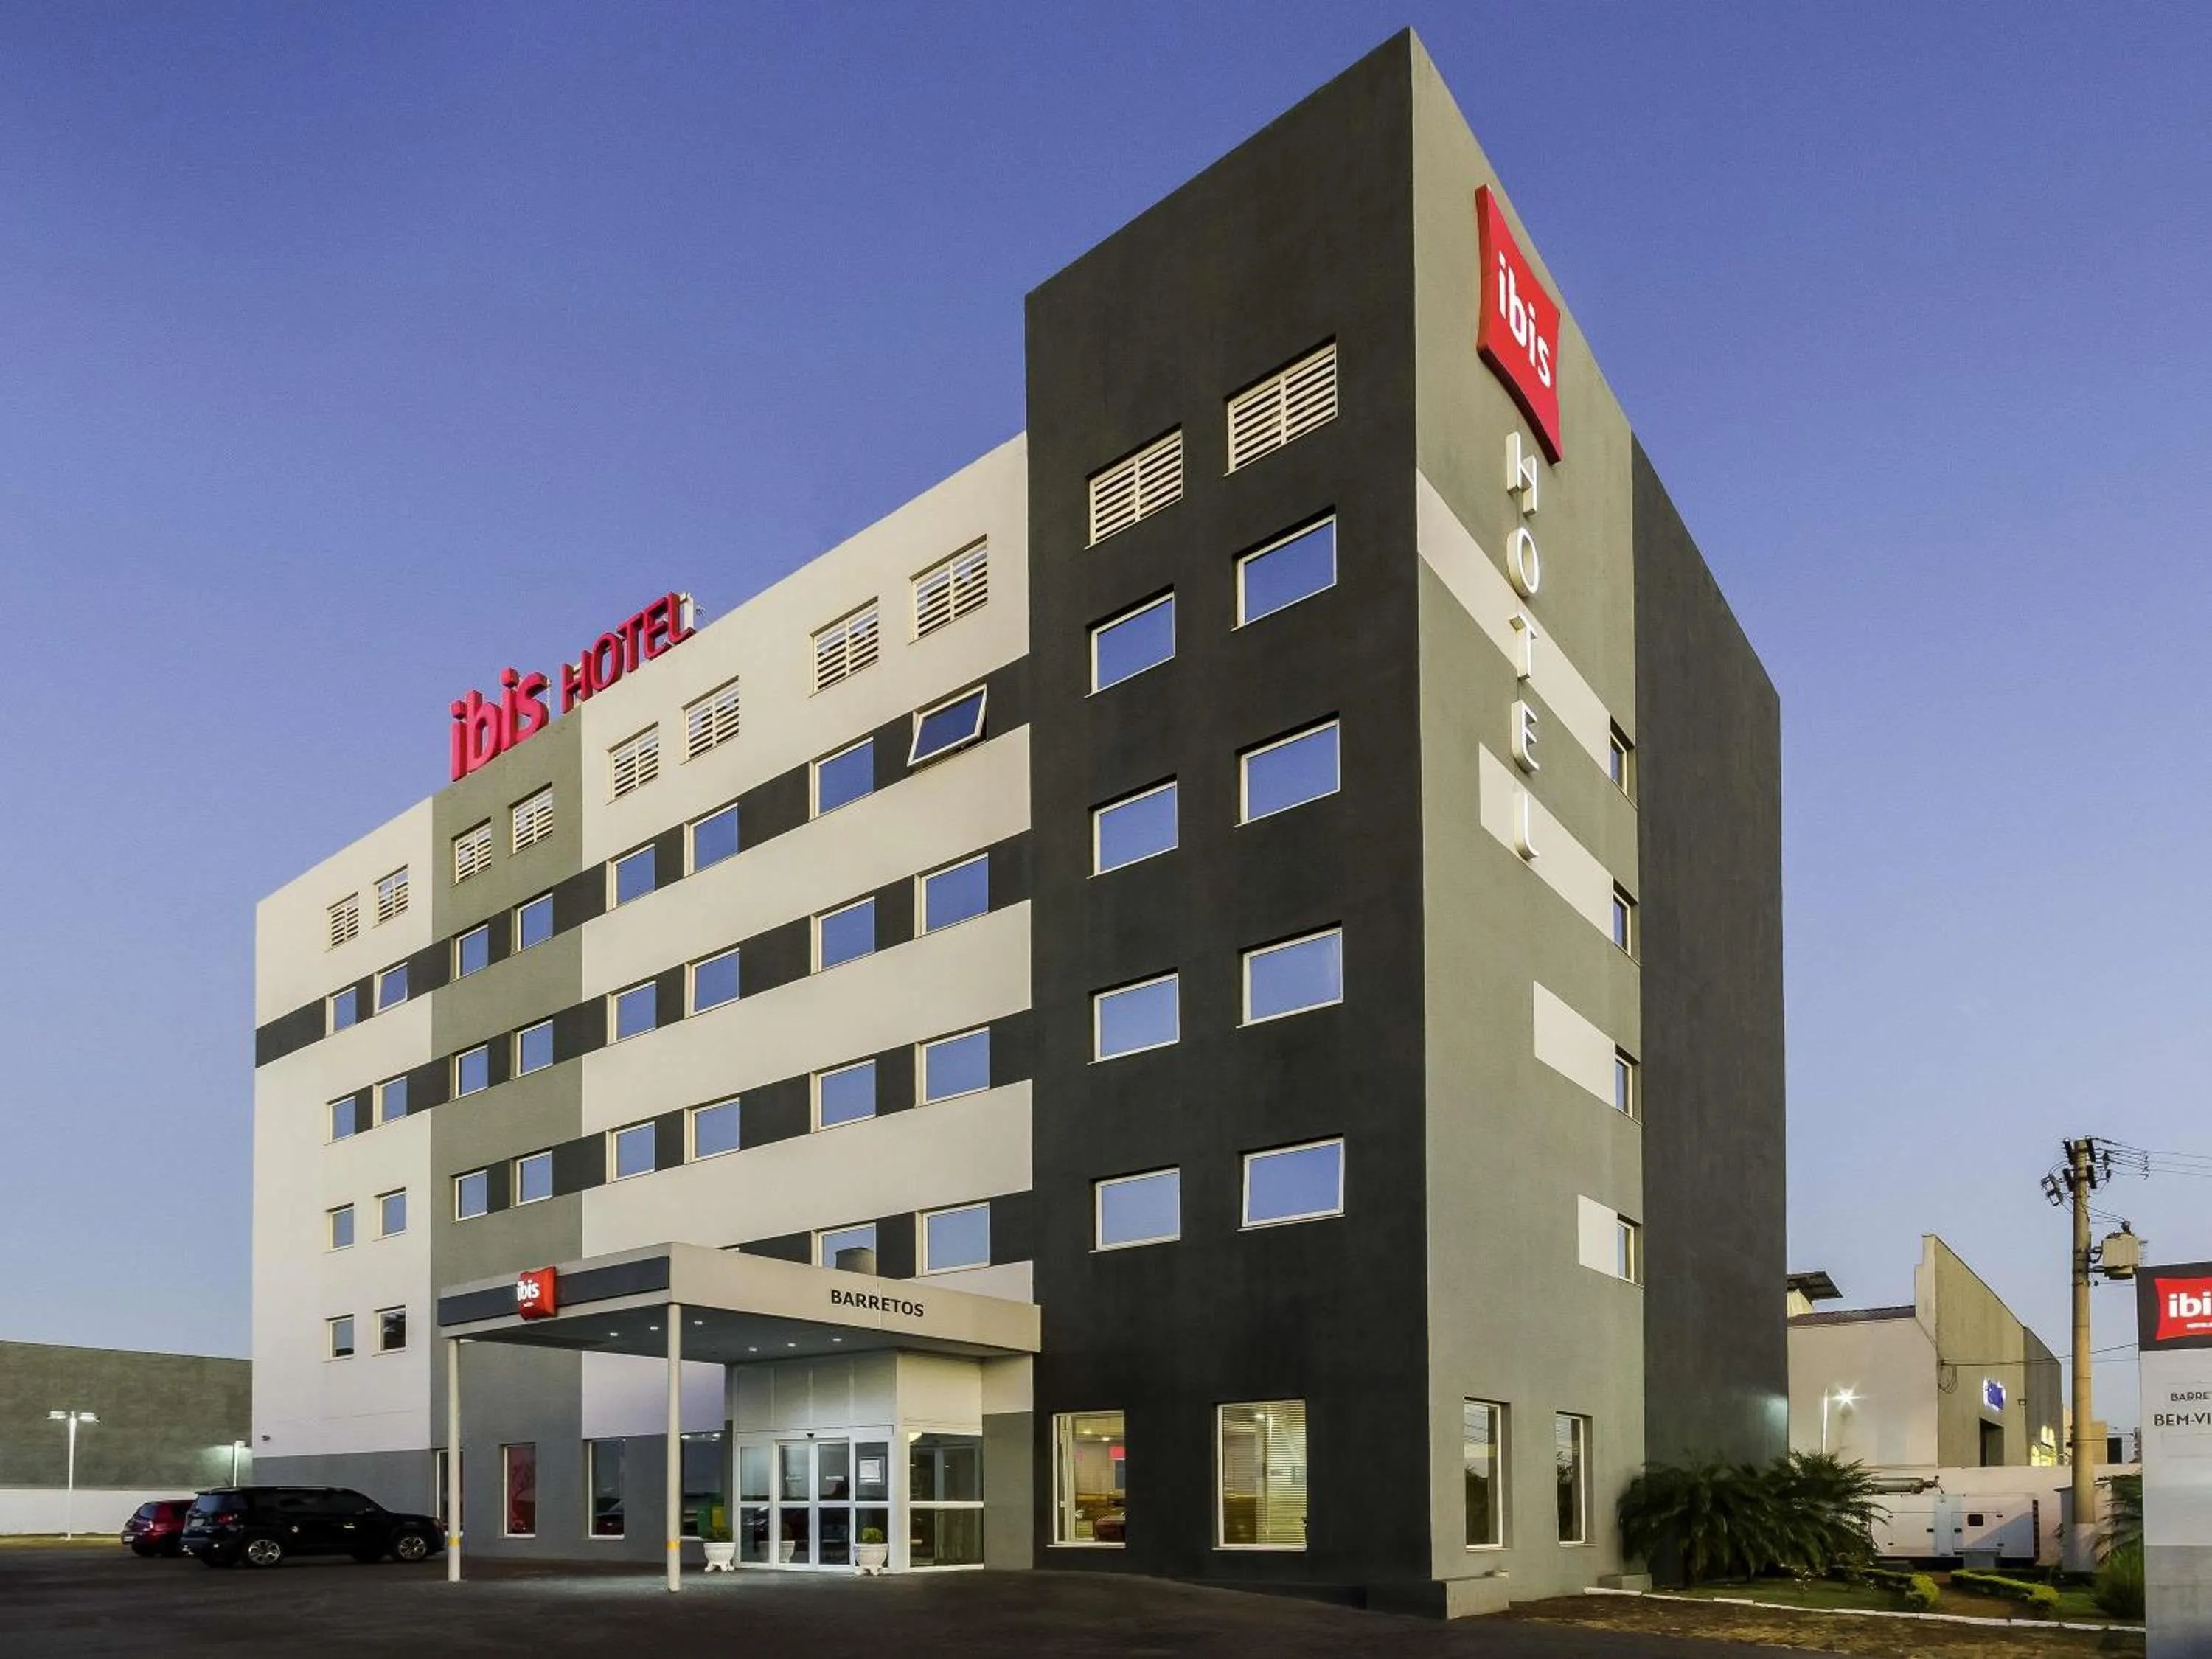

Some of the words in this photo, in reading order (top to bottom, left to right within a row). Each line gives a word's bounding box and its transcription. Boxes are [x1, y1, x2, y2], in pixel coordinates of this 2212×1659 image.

[1498, 250, 1551, 389] ibis
[450, 667, 549, 782] ibis
[561, 591, 697, 714] HOTEL
[1506, 431, 1539, 860] HOTEL
[517, 1279, 540, 1301] ibis
[831, 1290, 924, 1317] BARRETOS
[2171, 1391, 2212, 1401] BARRE
